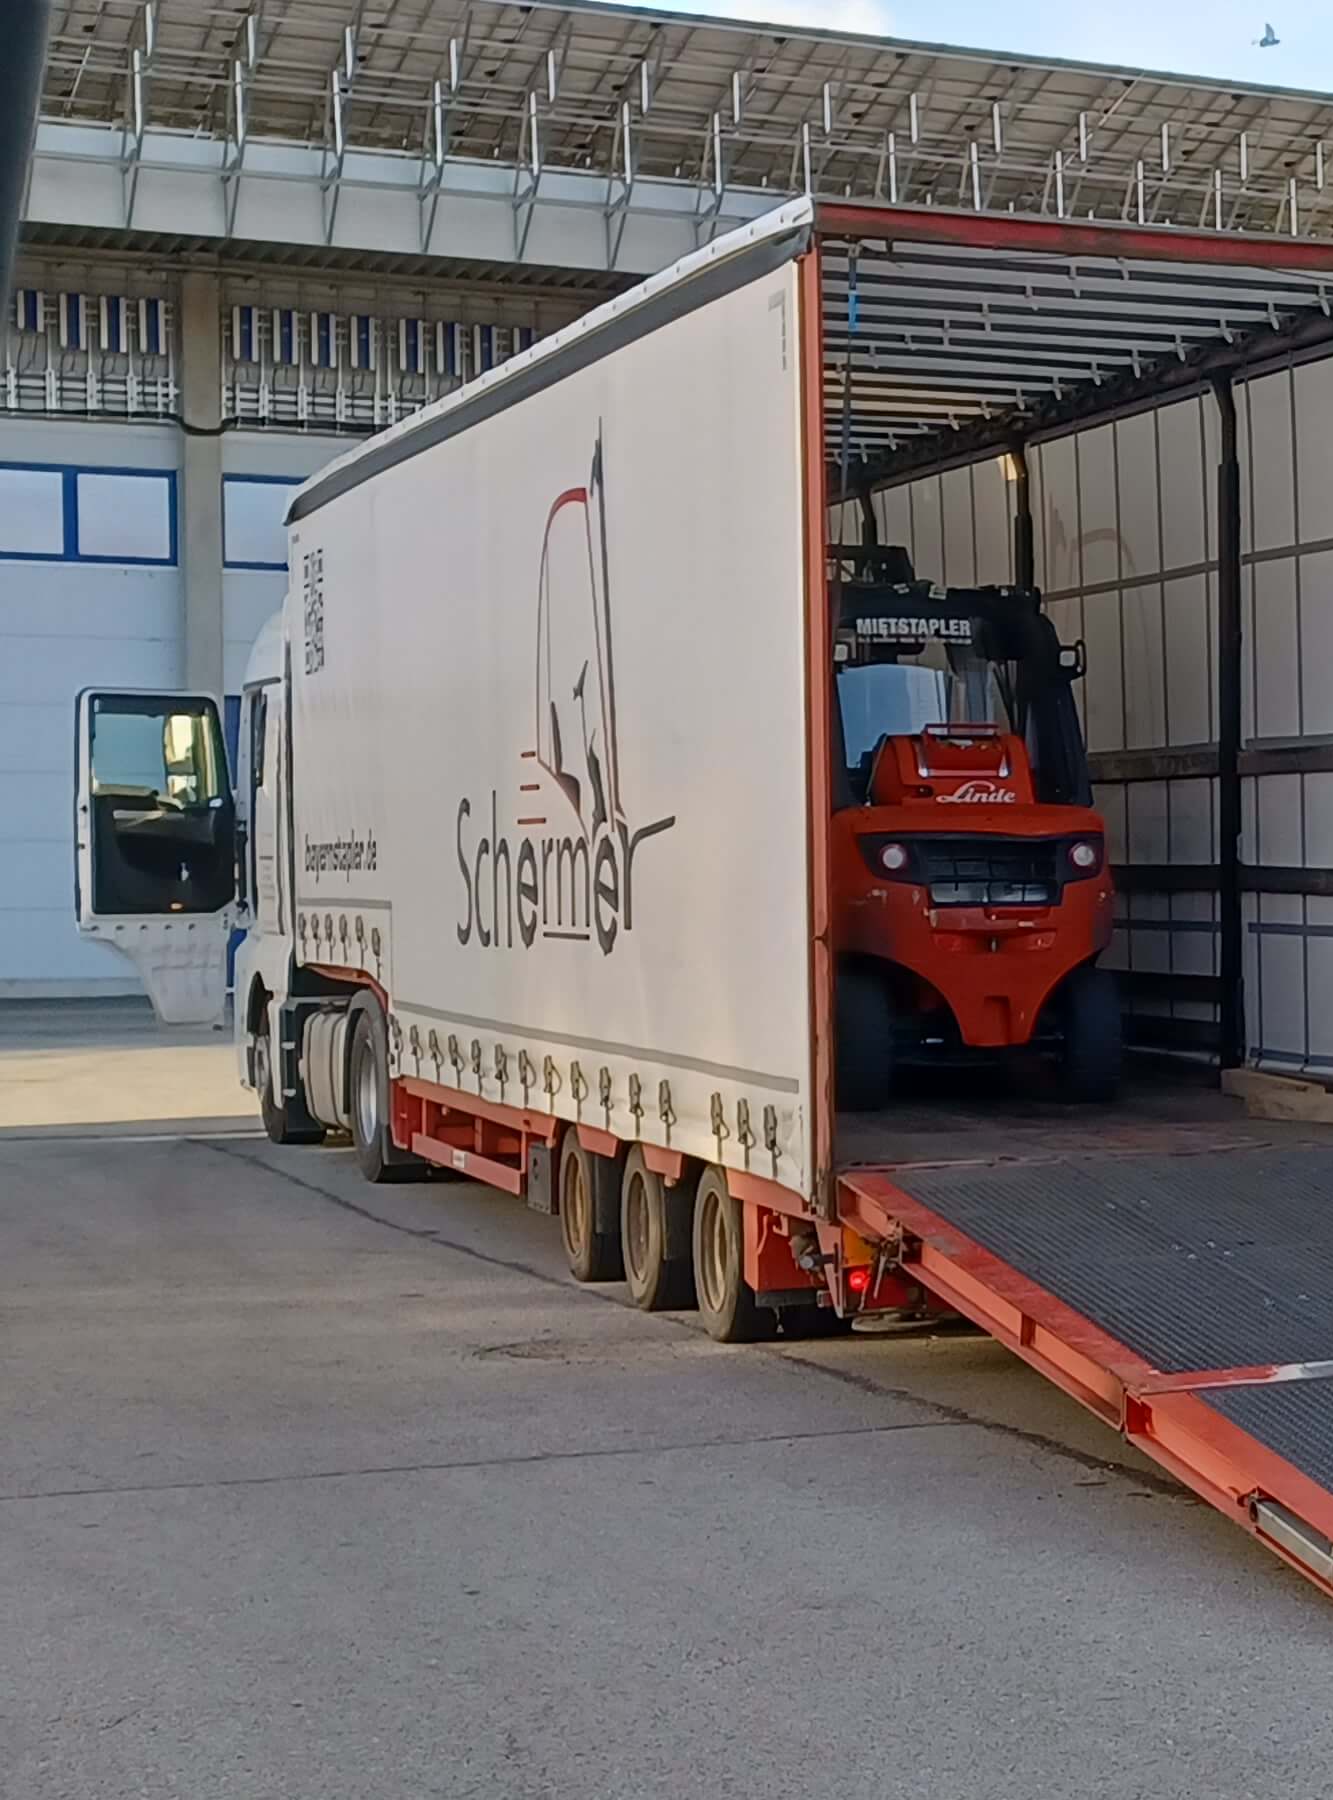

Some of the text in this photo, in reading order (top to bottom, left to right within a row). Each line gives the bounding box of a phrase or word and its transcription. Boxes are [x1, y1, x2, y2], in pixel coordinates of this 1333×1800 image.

[856, 618, 972, 637] MIETSTAPLER
[936, 780, 1016, 804] Linde
[304, 828, 377, 884] bayernstapler.de
[457, 790, 676, 956] Schermer
